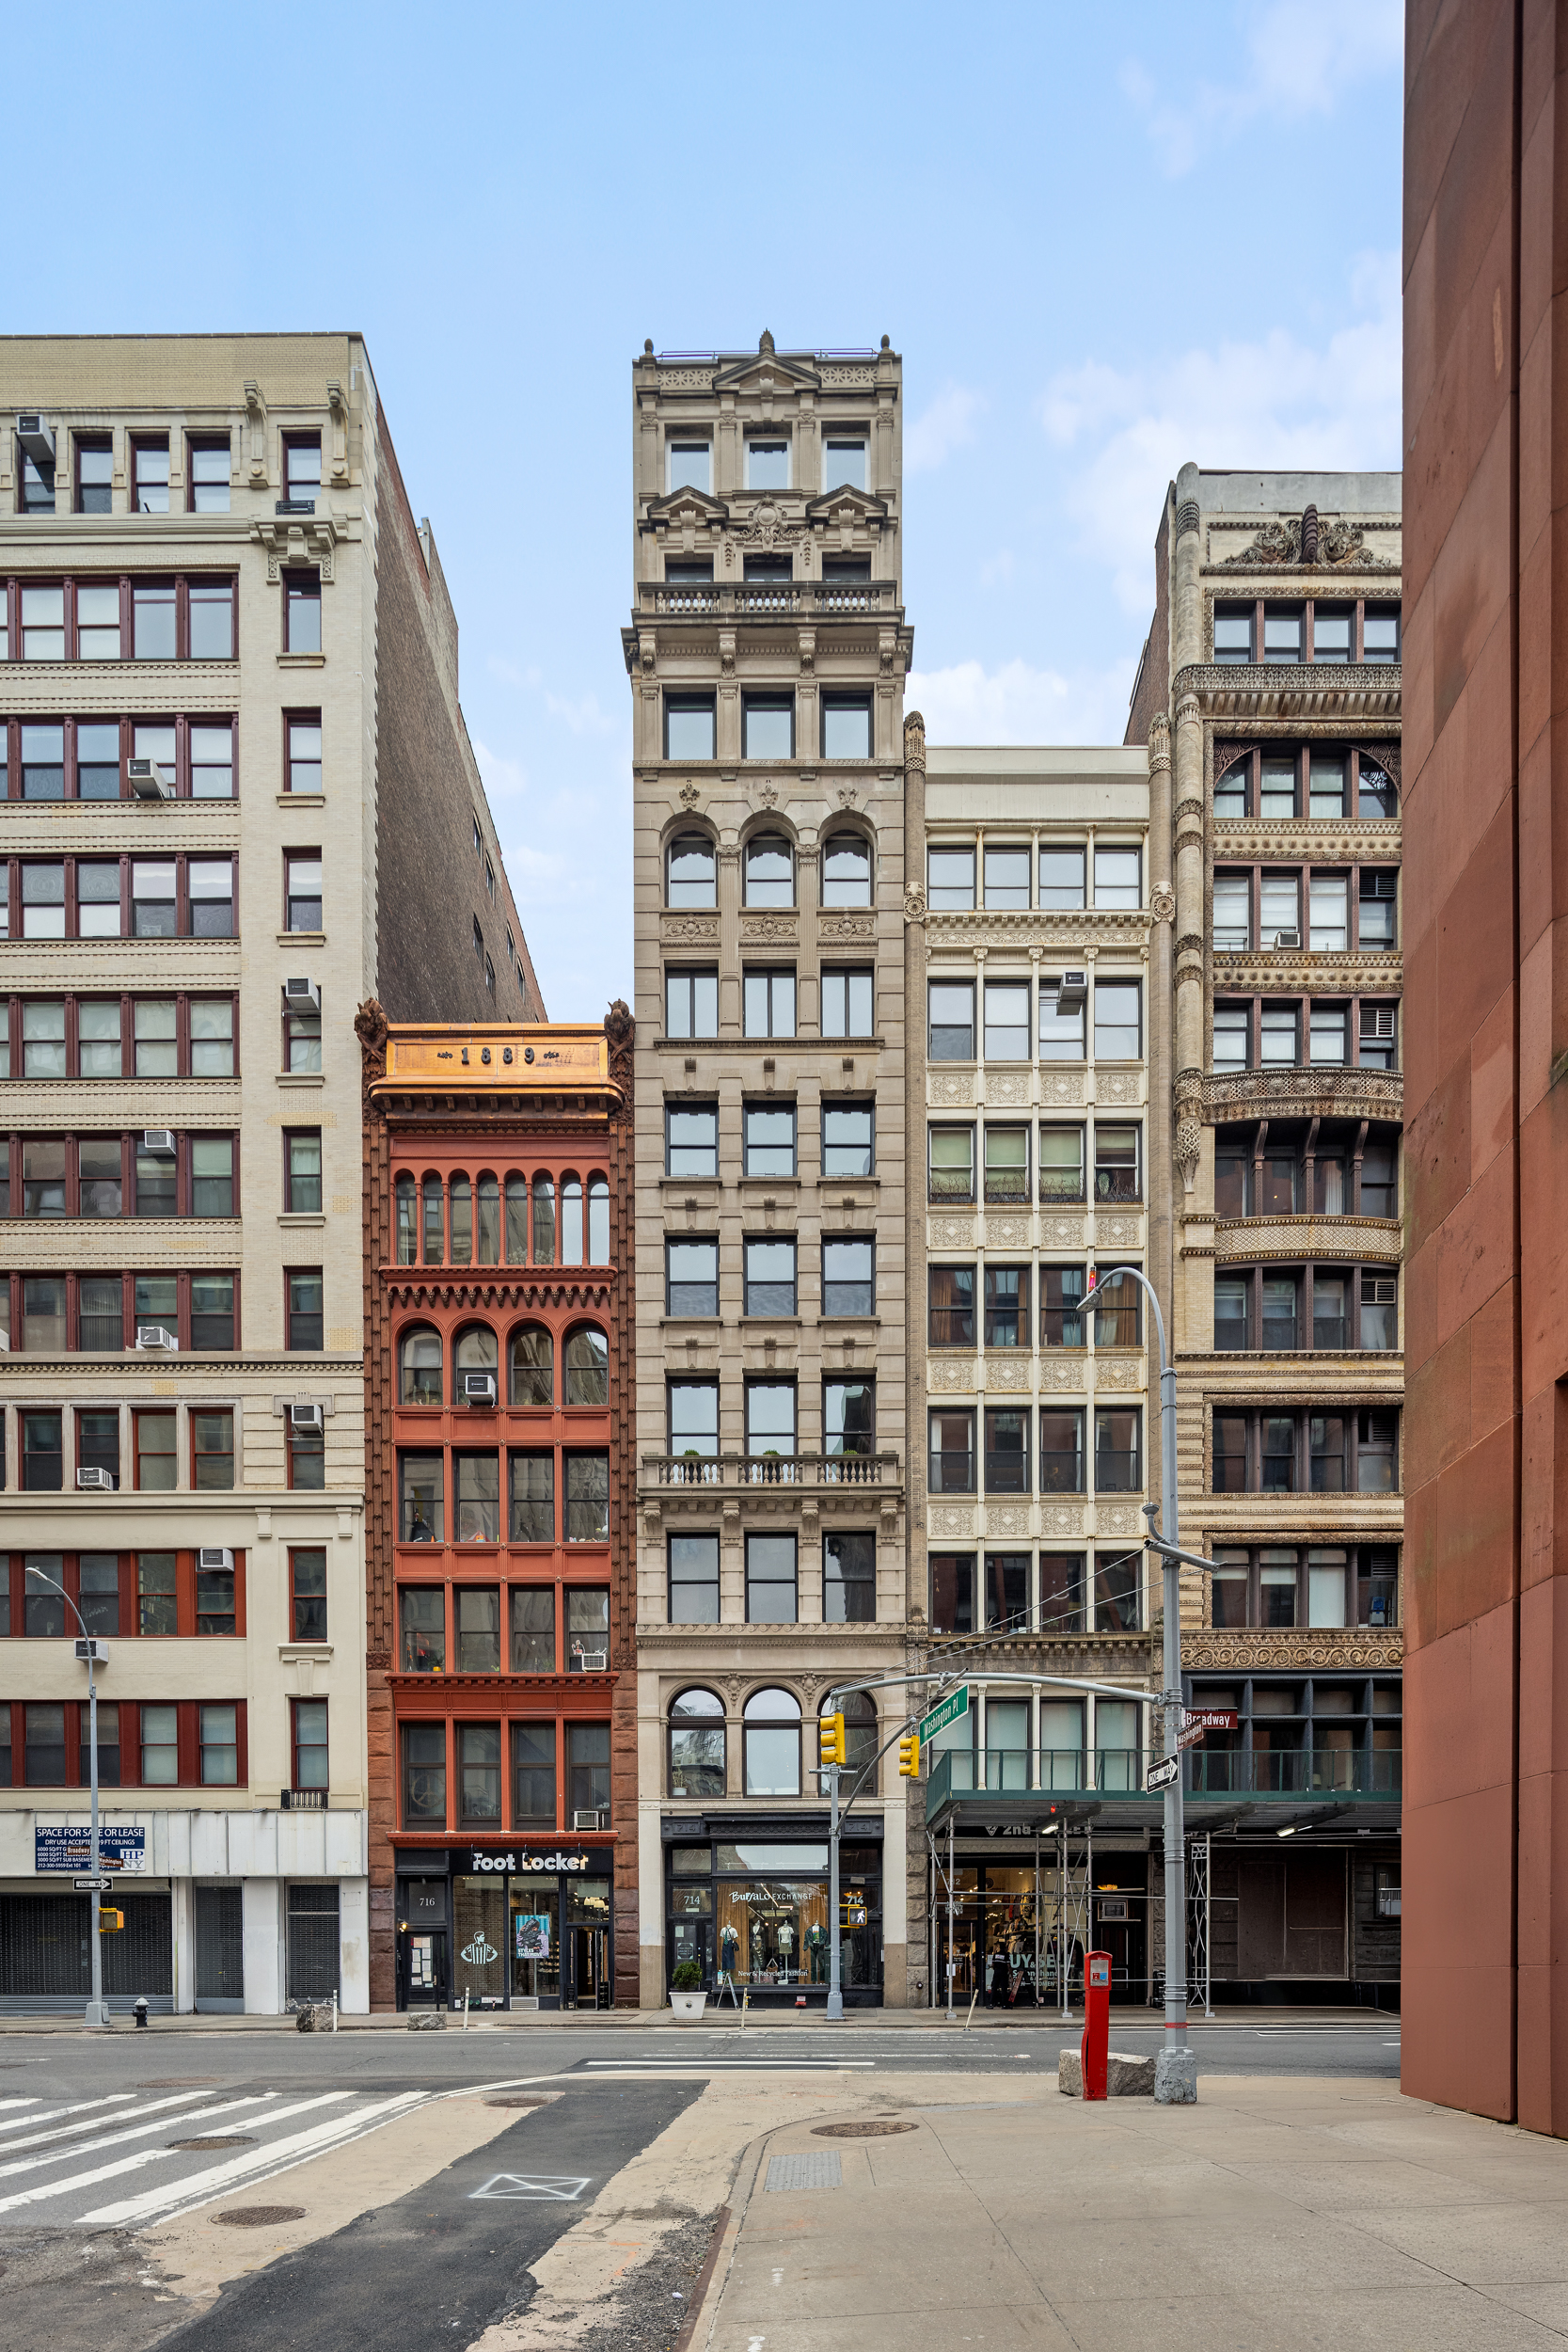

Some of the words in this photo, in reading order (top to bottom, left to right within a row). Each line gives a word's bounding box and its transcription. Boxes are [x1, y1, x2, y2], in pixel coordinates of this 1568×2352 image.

[461, 1047, 534, 1065] 1889
[925, 1705, 952, 1737] Washington
[952, 1696, 958, 1715] Pl
[1177, 1724, 1202, 1745] Washington
[1149, 1771, 1159, 1785] ONE
[1164, 1763, 1174, 1777] WAY
[37, 1828, 63, 1837] SPACE
[64, 1828, 82, 1837] FOR
[83, 1828, 103, 1837] SAE
[104, 1828, 118, 1837] OR
[119, 1828, 144, 1837] LEASE
[122, 1851, 144, 1859] HP
[123, 1860, 144, 1869] NY
[472, 1852, 516, 1870] Foot
[522, 1852, 589, 1870] Locker
[420, 1898, 436, 1907] 716
[684, 1895, 701, 1905] 714
[847, 1895, 864, 1905] 714
[759, 1970, 784, 1979] Recycled
